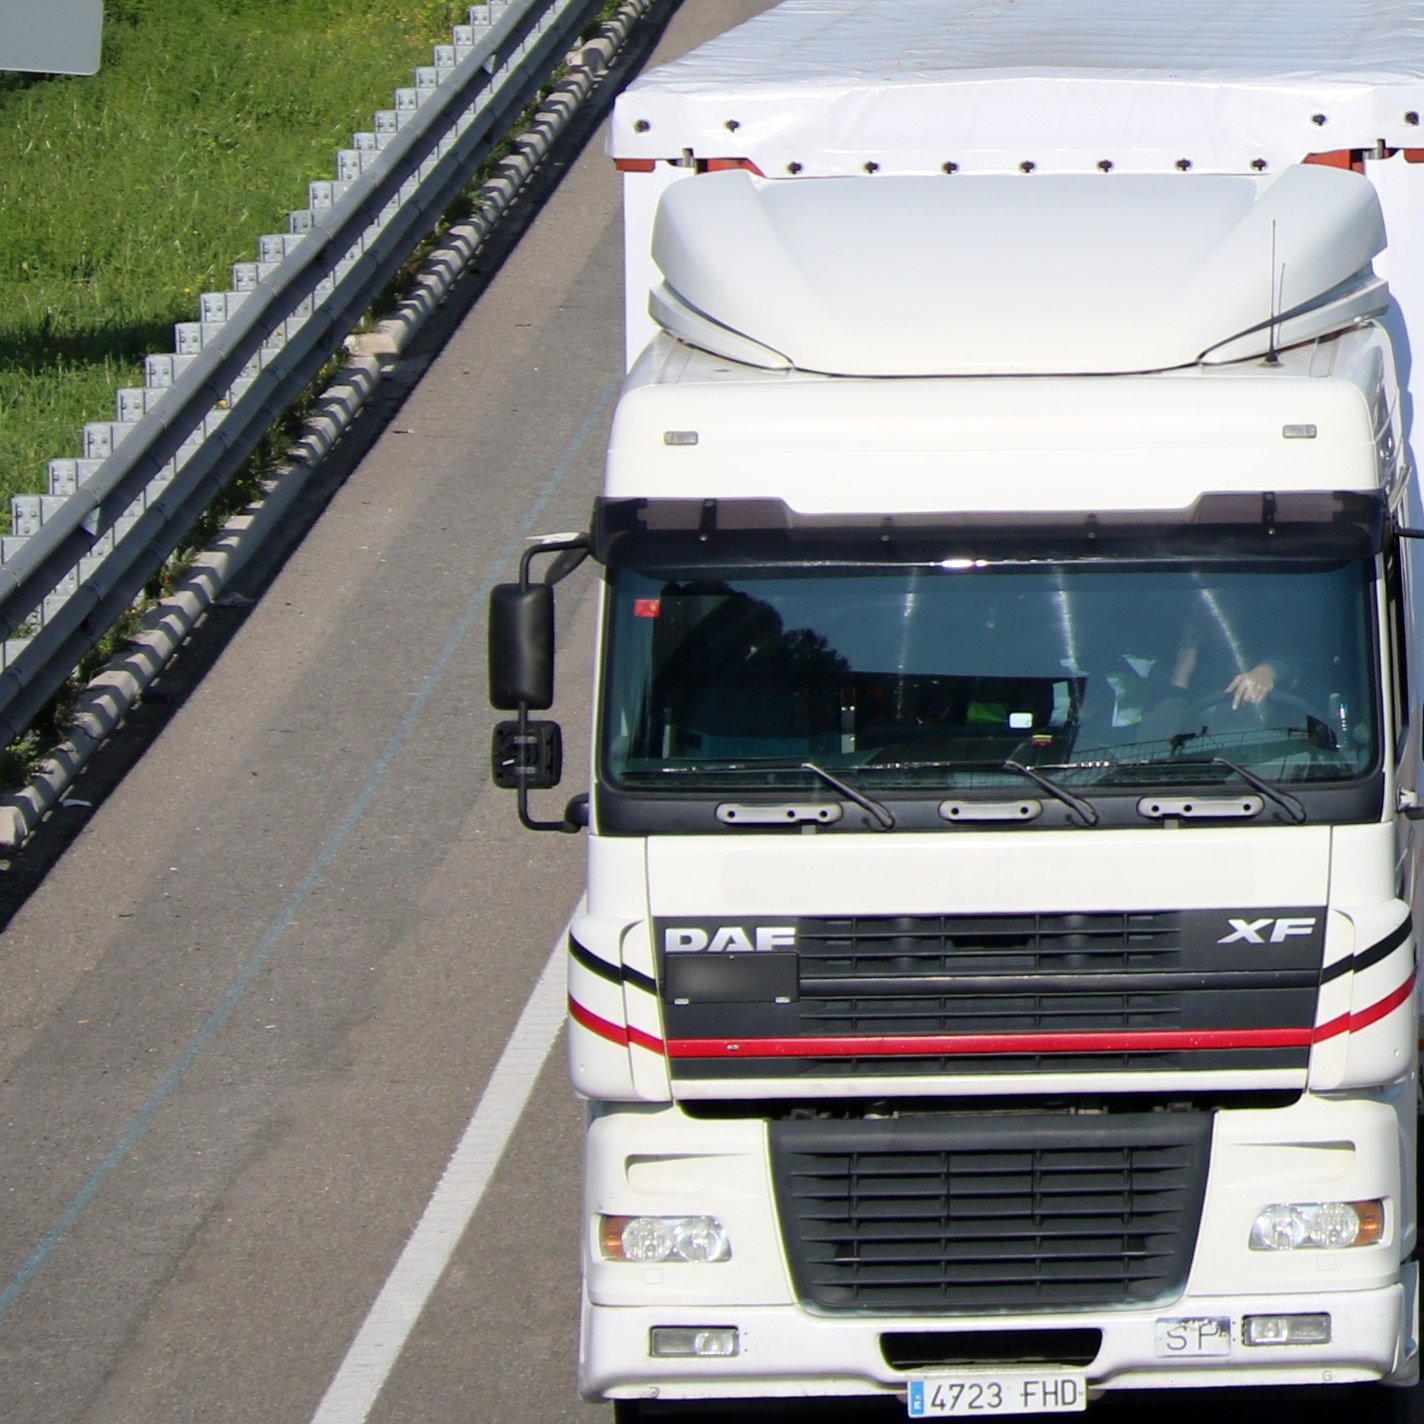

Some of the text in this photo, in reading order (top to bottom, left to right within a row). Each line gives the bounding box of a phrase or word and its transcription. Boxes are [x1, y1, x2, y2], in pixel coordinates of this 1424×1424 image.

[665, 926, 797, 952] DAF
[1217, 917, 1317, 944] XF
[930, 1381, 1003, 1411] 4723
[1022, 1379, 1078, 1408] FHD
